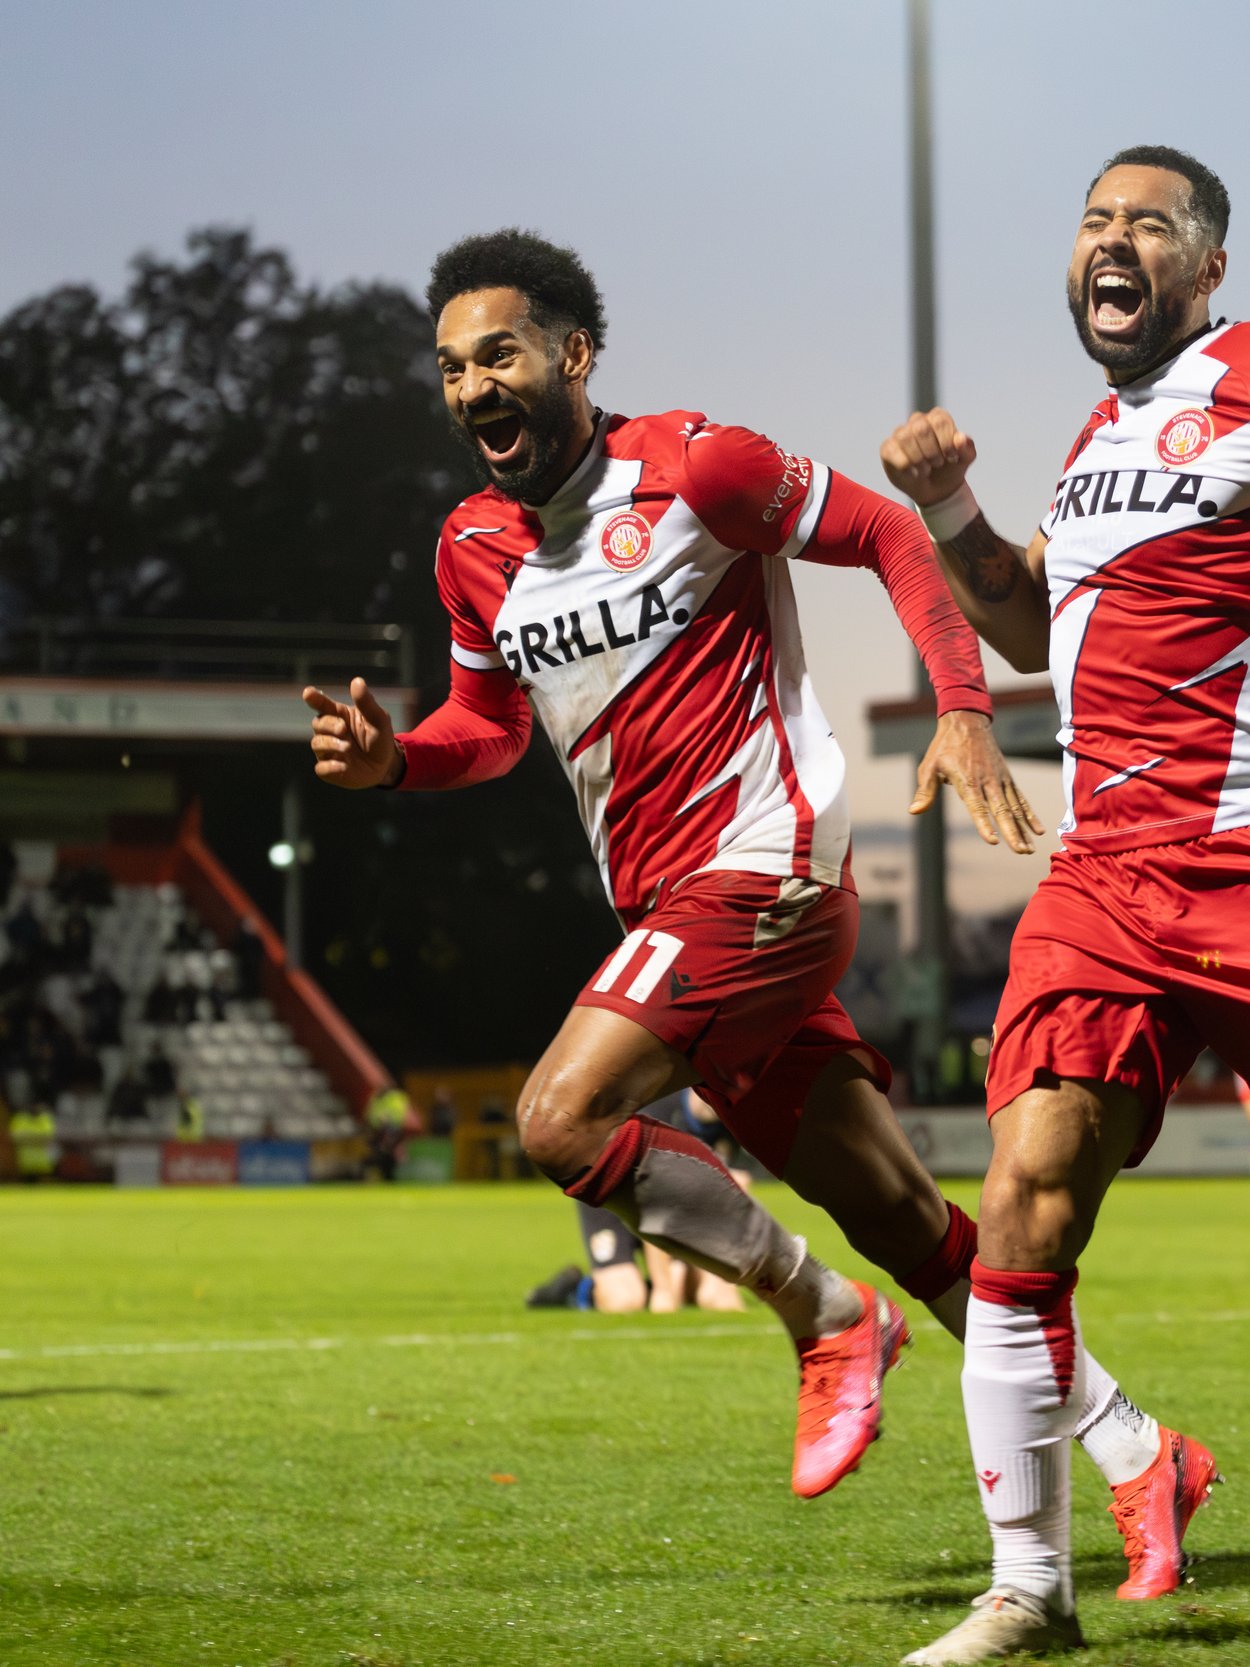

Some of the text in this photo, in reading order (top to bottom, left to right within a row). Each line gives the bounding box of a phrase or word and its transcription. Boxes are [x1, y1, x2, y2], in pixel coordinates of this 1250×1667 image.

[1172, 413, 1206, 425] STEVENAGE
[496, 583, 690, 679] GRILLA.
[592, 929, 685, 1004] 11
